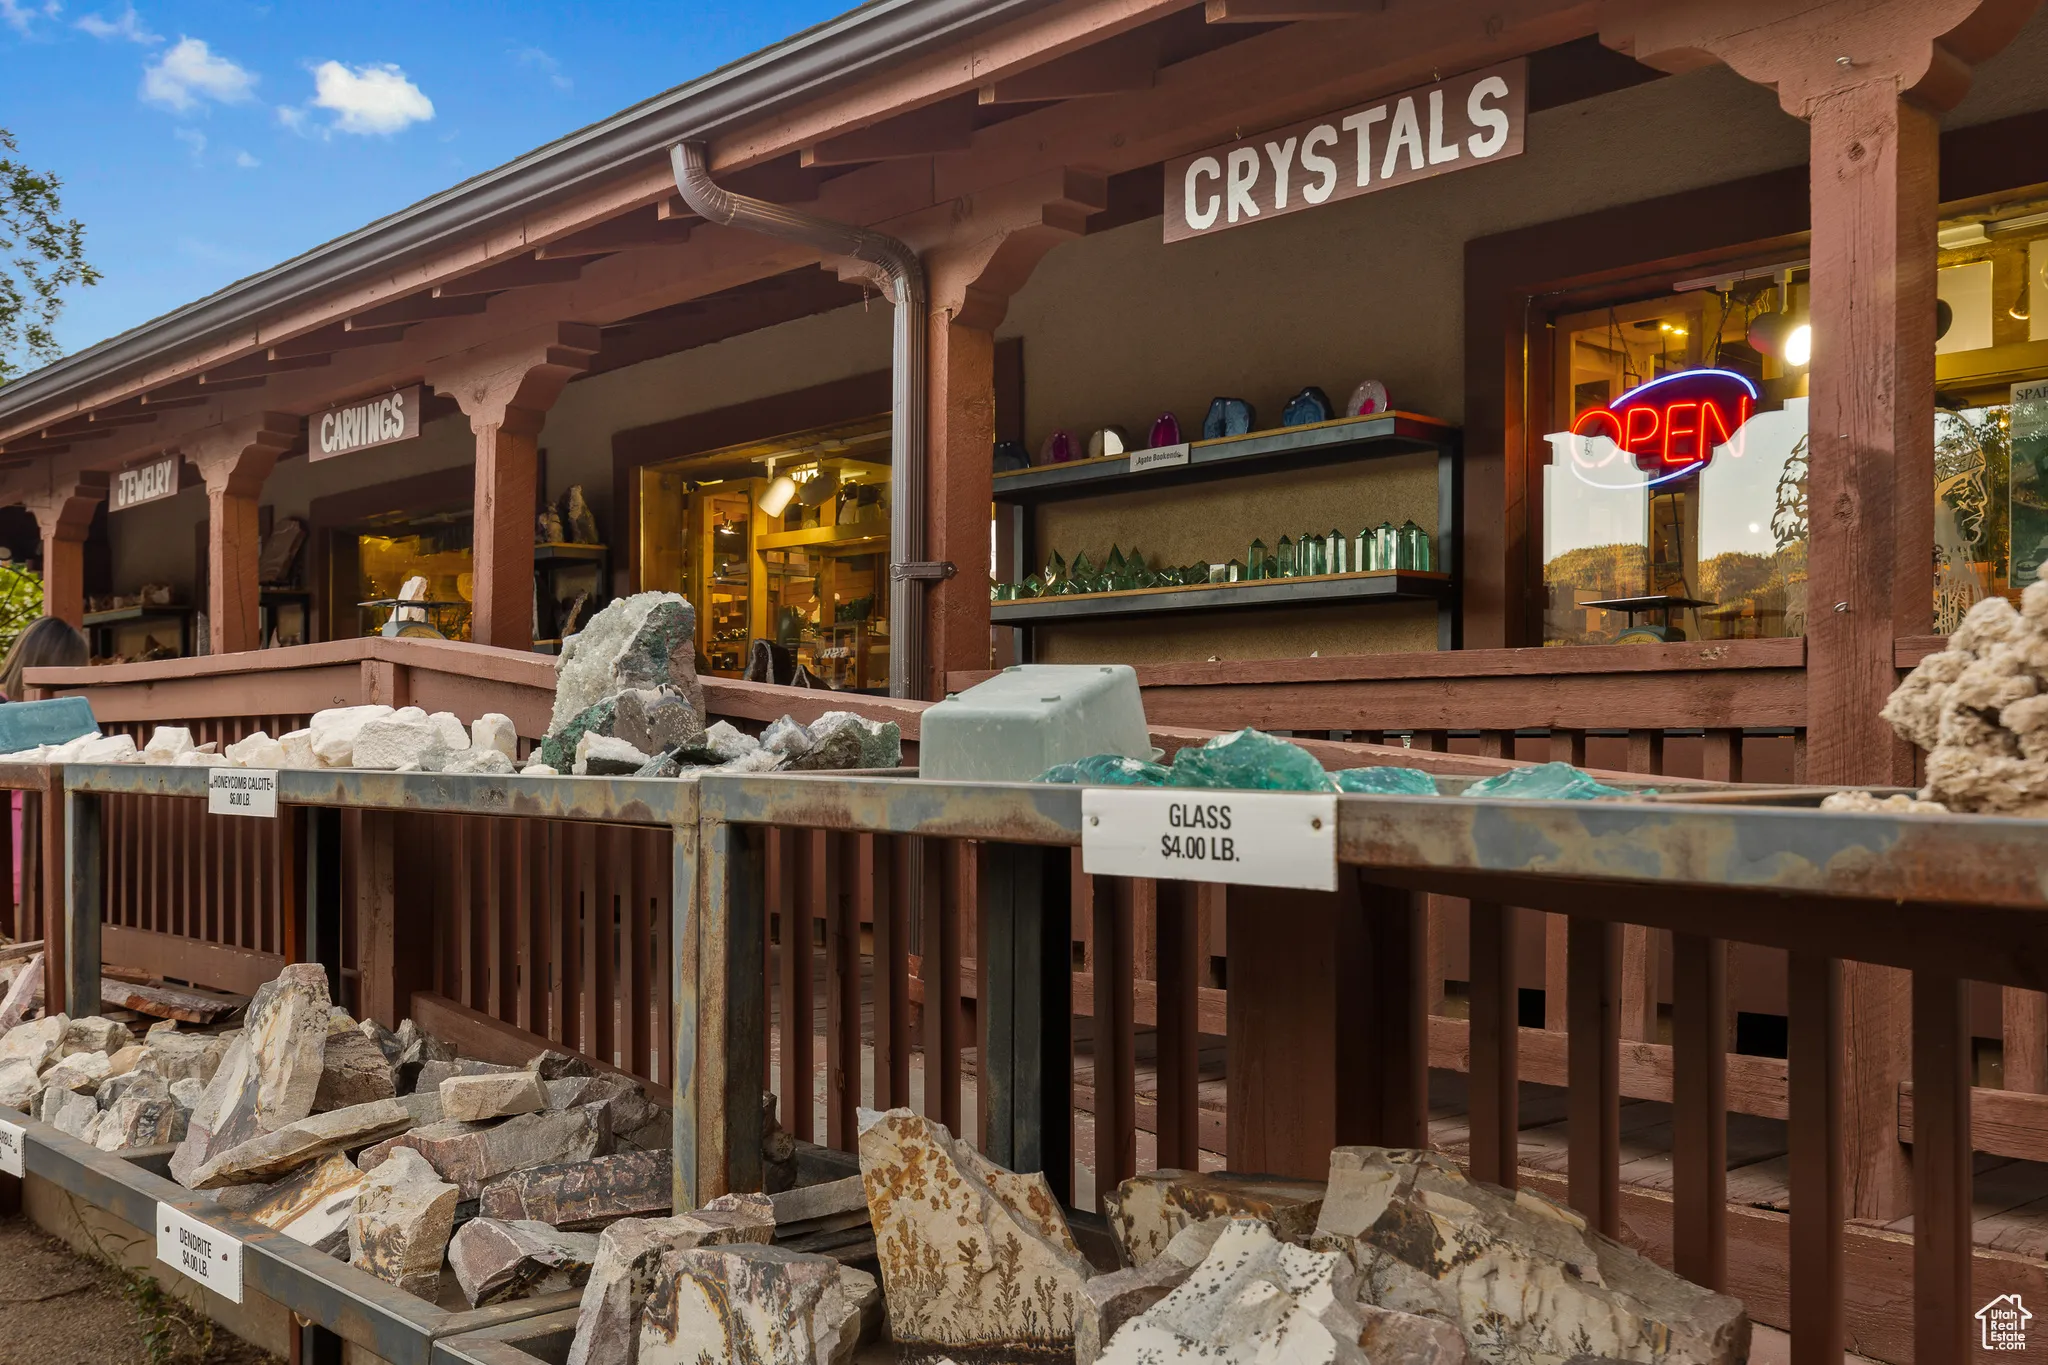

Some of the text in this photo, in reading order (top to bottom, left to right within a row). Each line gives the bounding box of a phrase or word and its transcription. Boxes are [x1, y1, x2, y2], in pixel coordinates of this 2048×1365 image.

[1185, 76, 1509, 229] CRYSTALS
[320, 393, 404, 453] CARVINGS
[1570, 397, 1748, 469] OPEN
[1136, 450, 1181, 466] Agate Bookends
[118, 459, 172, 507] JEWELRY
[213, 775, 270, 791] HONEYCOMB CALCITE
[243, 792, 251, 806] LB.
[1169, 803, 1232, 830] GLASS
[1161, 832, 1240, 862] $4.00 LB.
[179, 1226, 212, 1259] DENDRITE
[182, 1249, 209, 1278] $4.00 LB.
